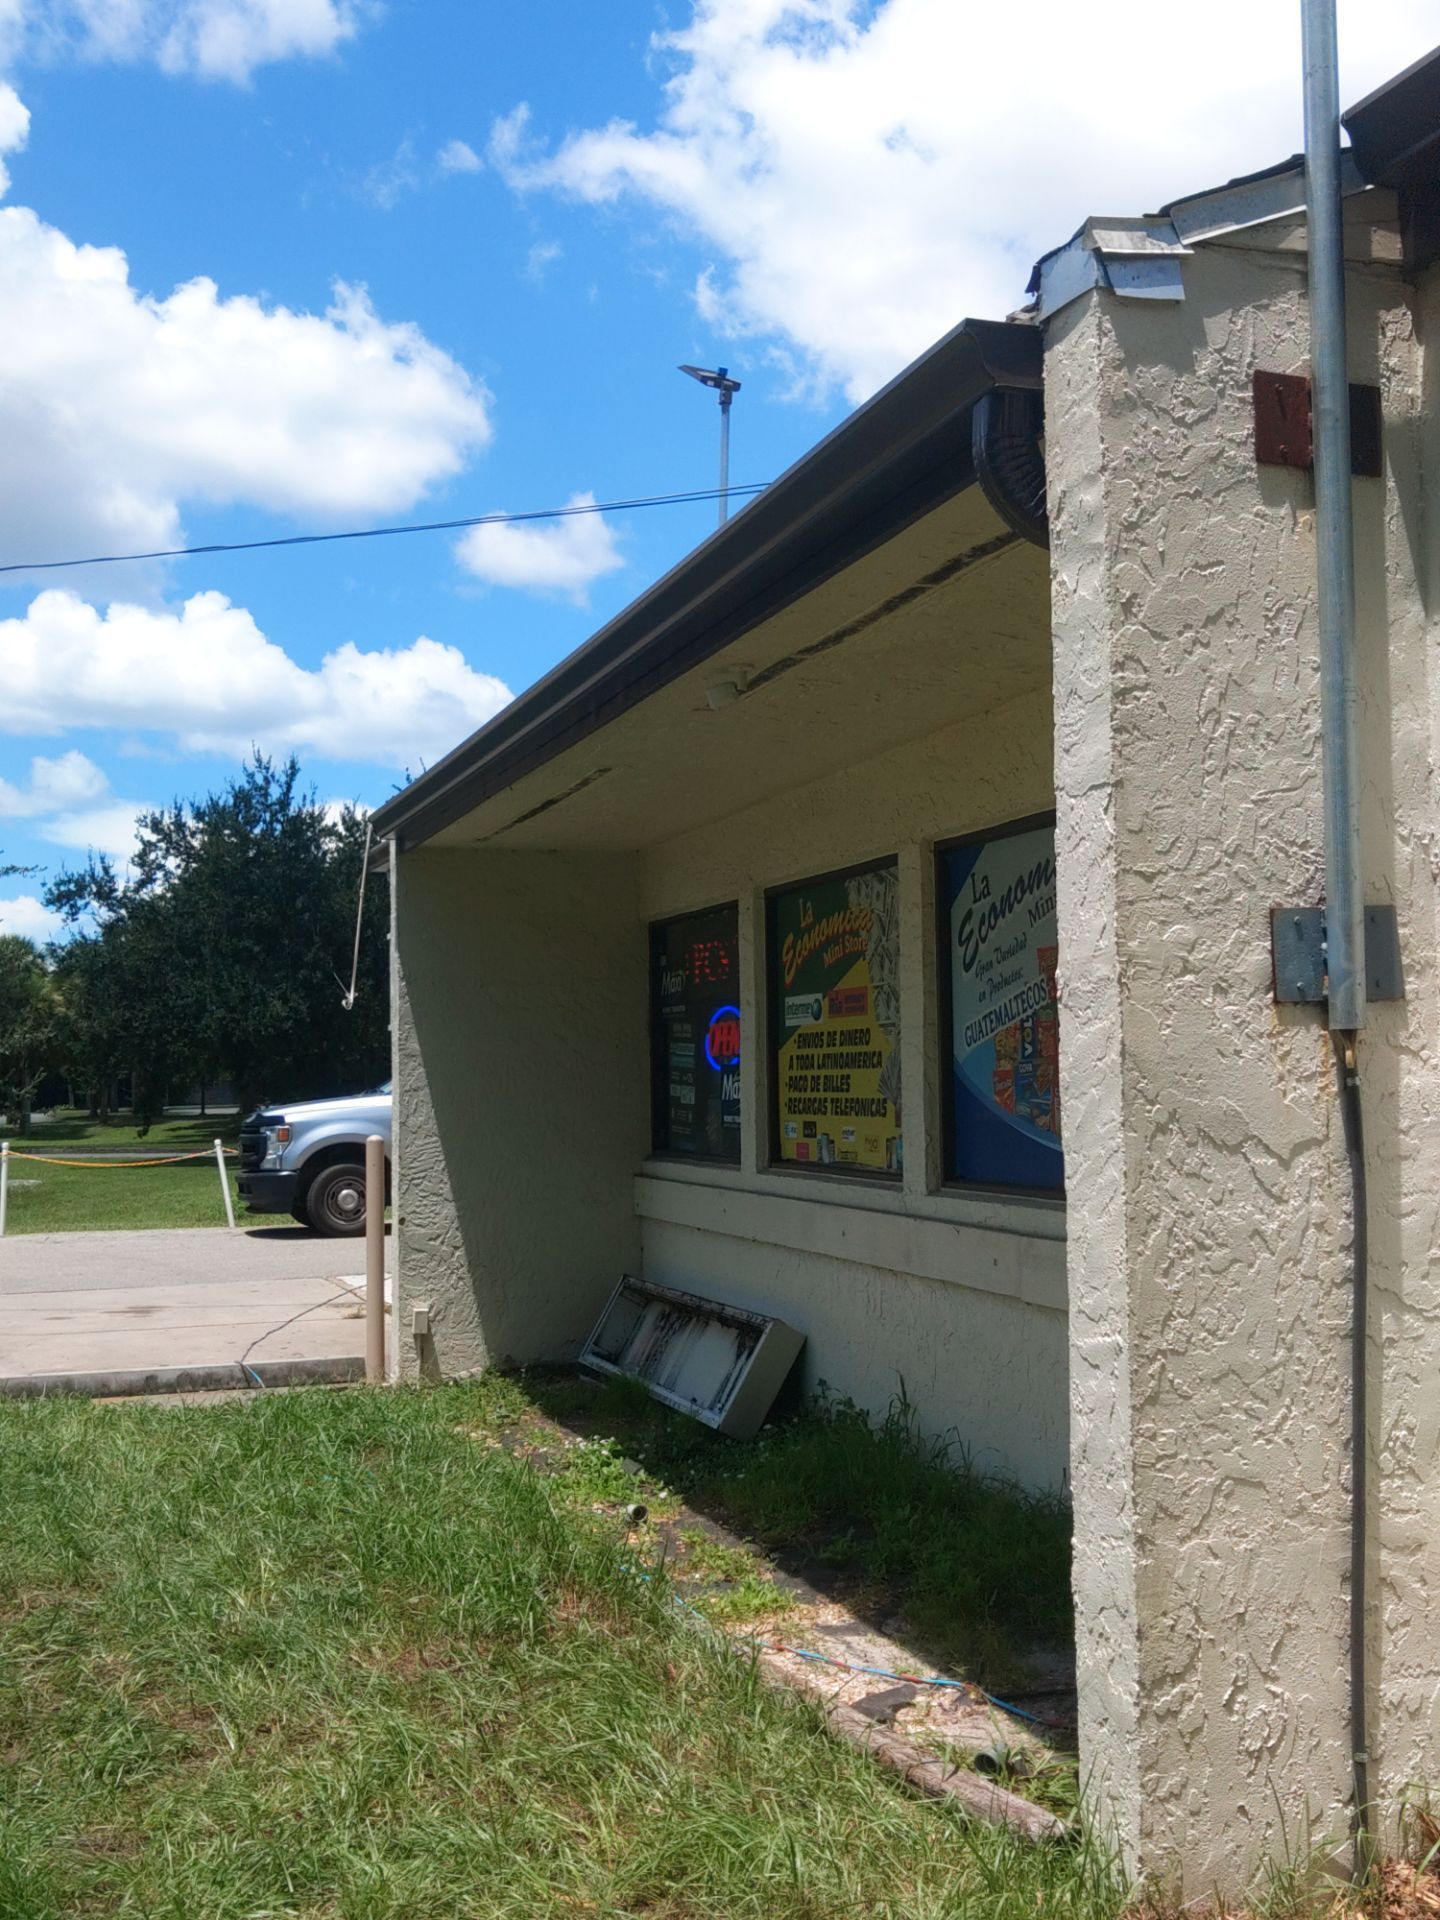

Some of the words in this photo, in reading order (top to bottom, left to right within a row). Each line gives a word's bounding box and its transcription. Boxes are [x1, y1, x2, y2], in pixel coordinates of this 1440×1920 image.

[970, 872, 991, 904] La
[799, 898, 813, 929] La
[958, 858, 1056, 973] Econom
[783, 908, 873, 990] Economita
[823, 939, 843, 968] Mini
[844, 933, 868, 955] Store
[976, 959, 994, 982] Gran
[993, 931, 1027, 965] Variedad
[965, 978, 1047, 1047] GUATEMALTECOS
[797, 1031, 824, 1050] ENVIOS
[826, 1030, 838, 1048] DE
[839, 1027, 871, 1047] DINERO
[788, 1055, 794, 1071] A
[796, 1053, 815, 1071] TODA
[817, 1050, 882, 1070] LATINOAMERICA
[788, 1075, 808, 1093] PAGO
[810, 1075, 821, 1092] DE
[823, 1074, 850, 1092] BILLES
[788, 1097, 828, 1116] RECARGAS
[830, 1097, 887, 1118] TELEFONICAS
